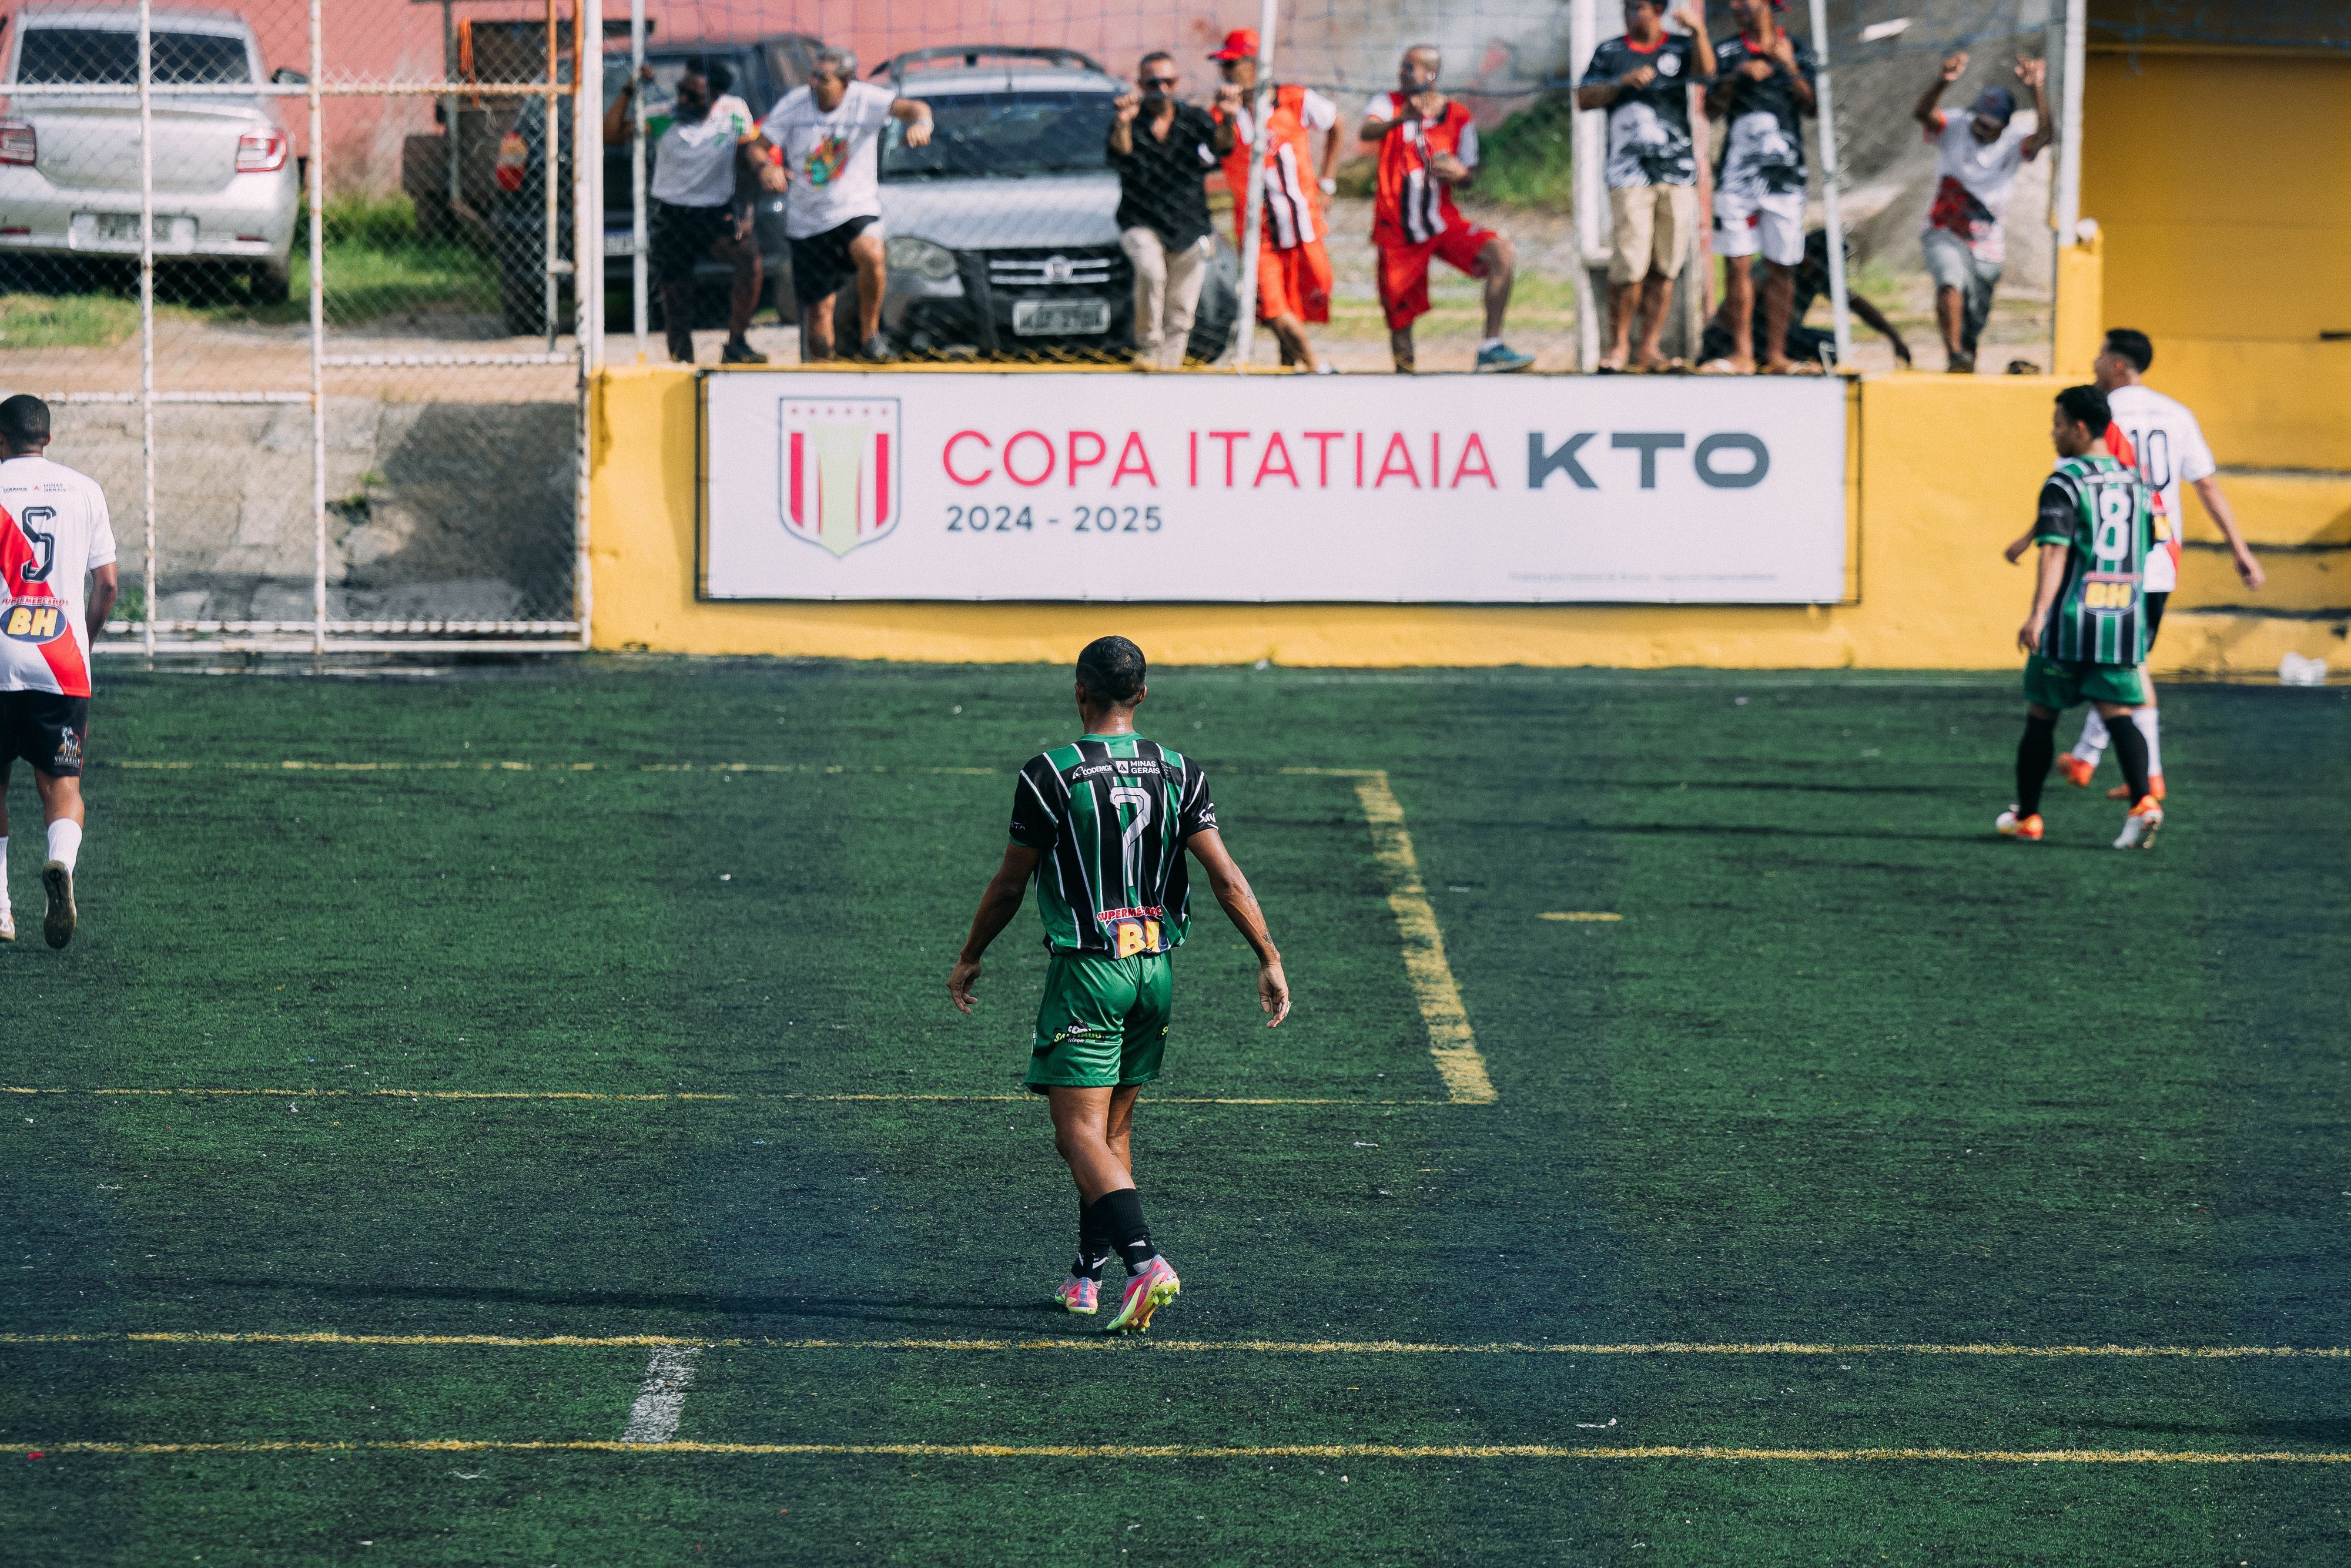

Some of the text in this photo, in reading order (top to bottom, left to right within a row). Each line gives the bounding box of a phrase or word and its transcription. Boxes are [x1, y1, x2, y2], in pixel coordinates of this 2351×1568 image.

[942, 430, 1771, 490] COPA ITATIAIA KTO
[22, 505, 57, 583] 5
[946, 505, 1034, 532] 2024
[1074, 505, 1162, 532] 2025
[2094, 489, 2133, 561] 8
[7, 607, 59, 637] BH
[1083, 765, 1113, 775] CODEMGE
[1109, 786, 1151, 887] 7
